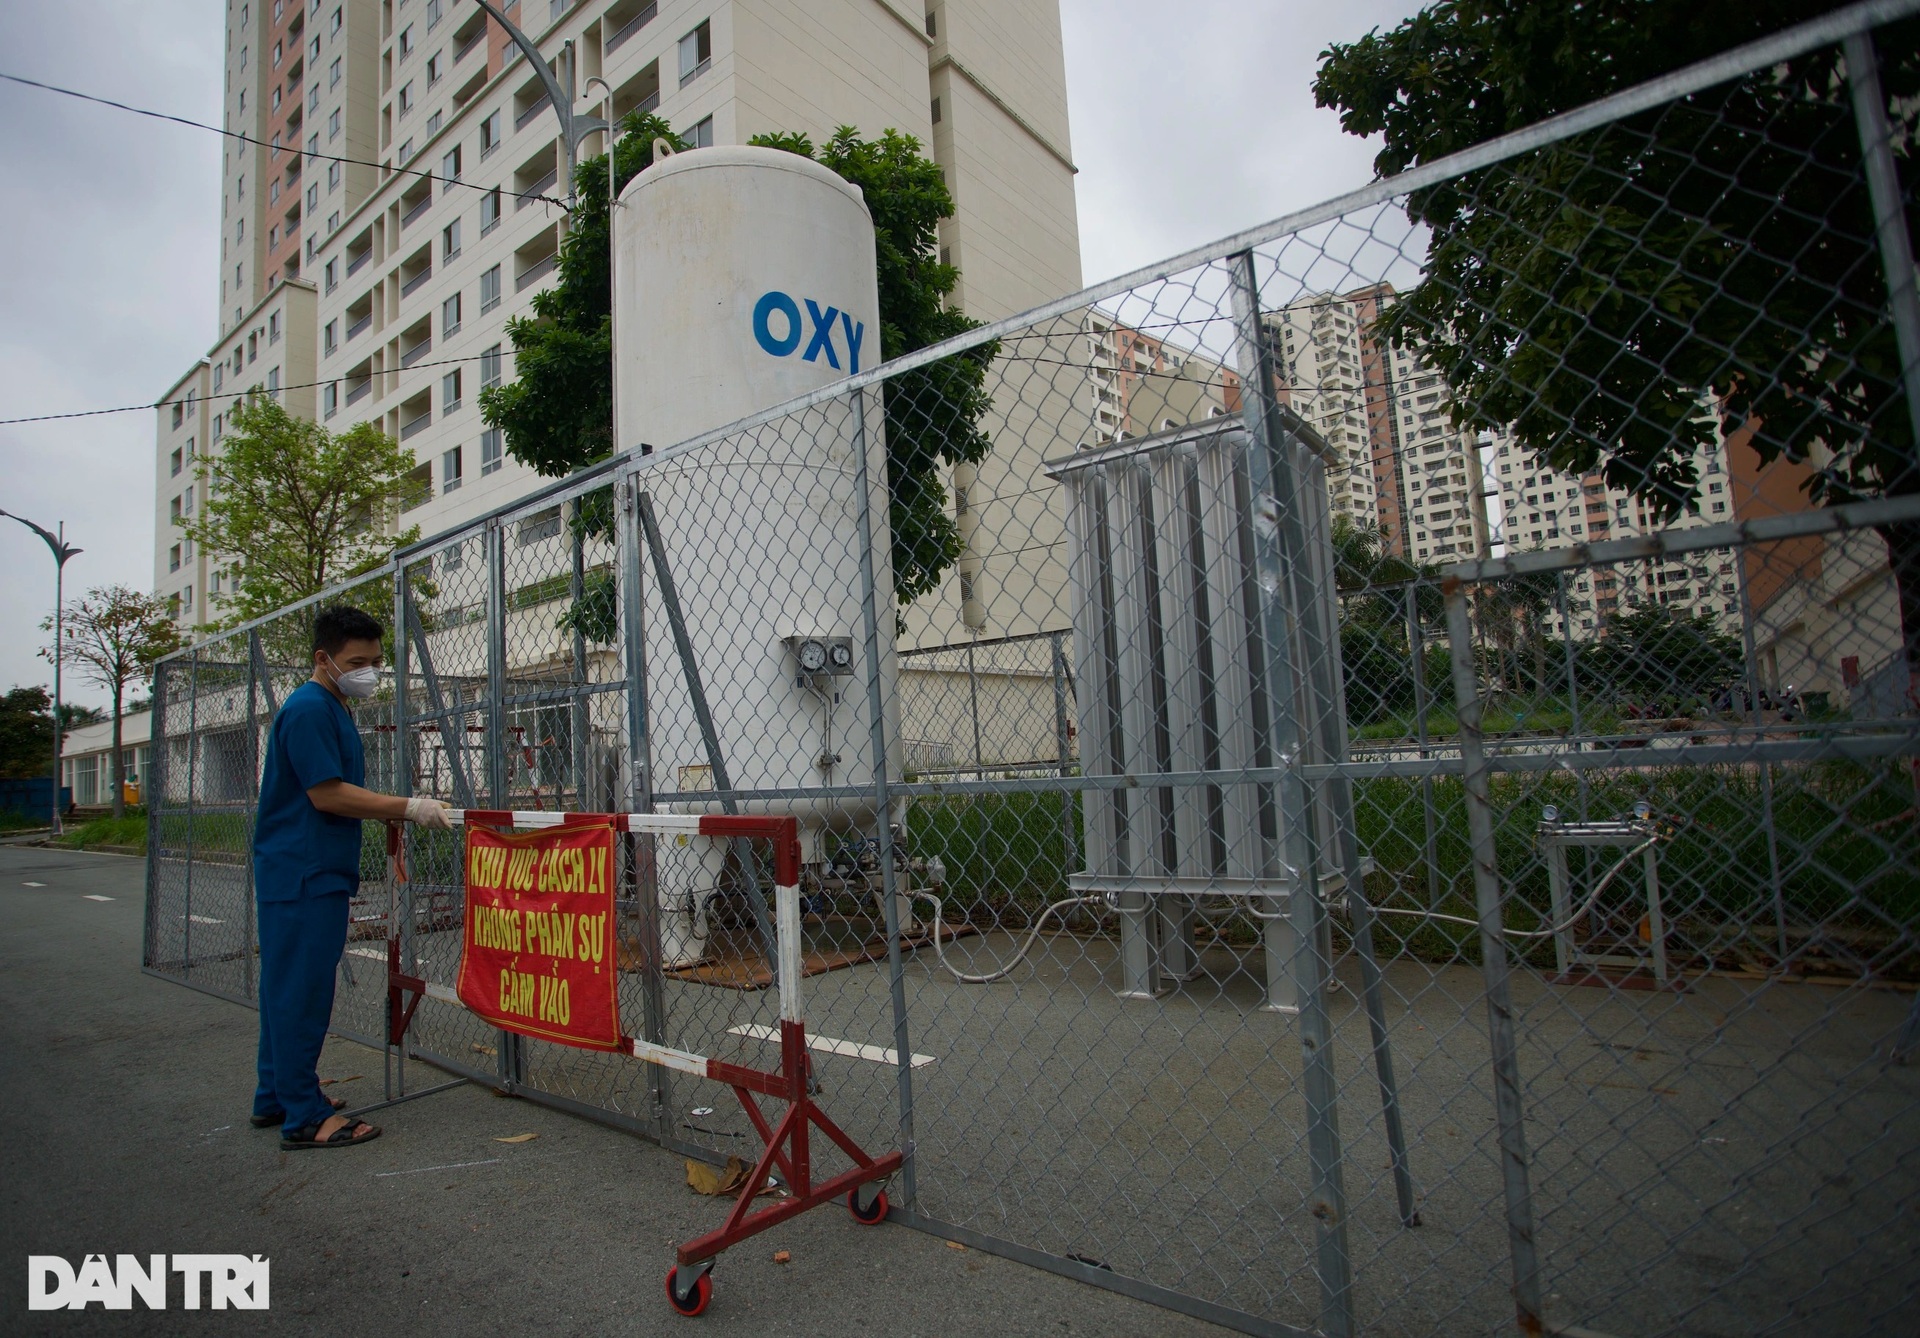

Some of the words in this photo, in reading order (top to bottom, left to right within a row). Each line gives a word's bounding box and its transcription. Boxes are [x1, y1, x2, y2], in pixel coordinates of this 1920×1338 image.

[752, 291, 864, 375] OXY
[471, 846, 507, 889] KHU
[506, 845, 539, 900] VỰC
[538, 839, 584, 893] CÁCH
[588, 847, 607, 894] LY
[474, 898, 521, 953] KHÔNG
[578, 911, 606, 974] SỰ
[500, 956, 534, 1018] CẤM
[539, 966, 570, 1026] VÀO
